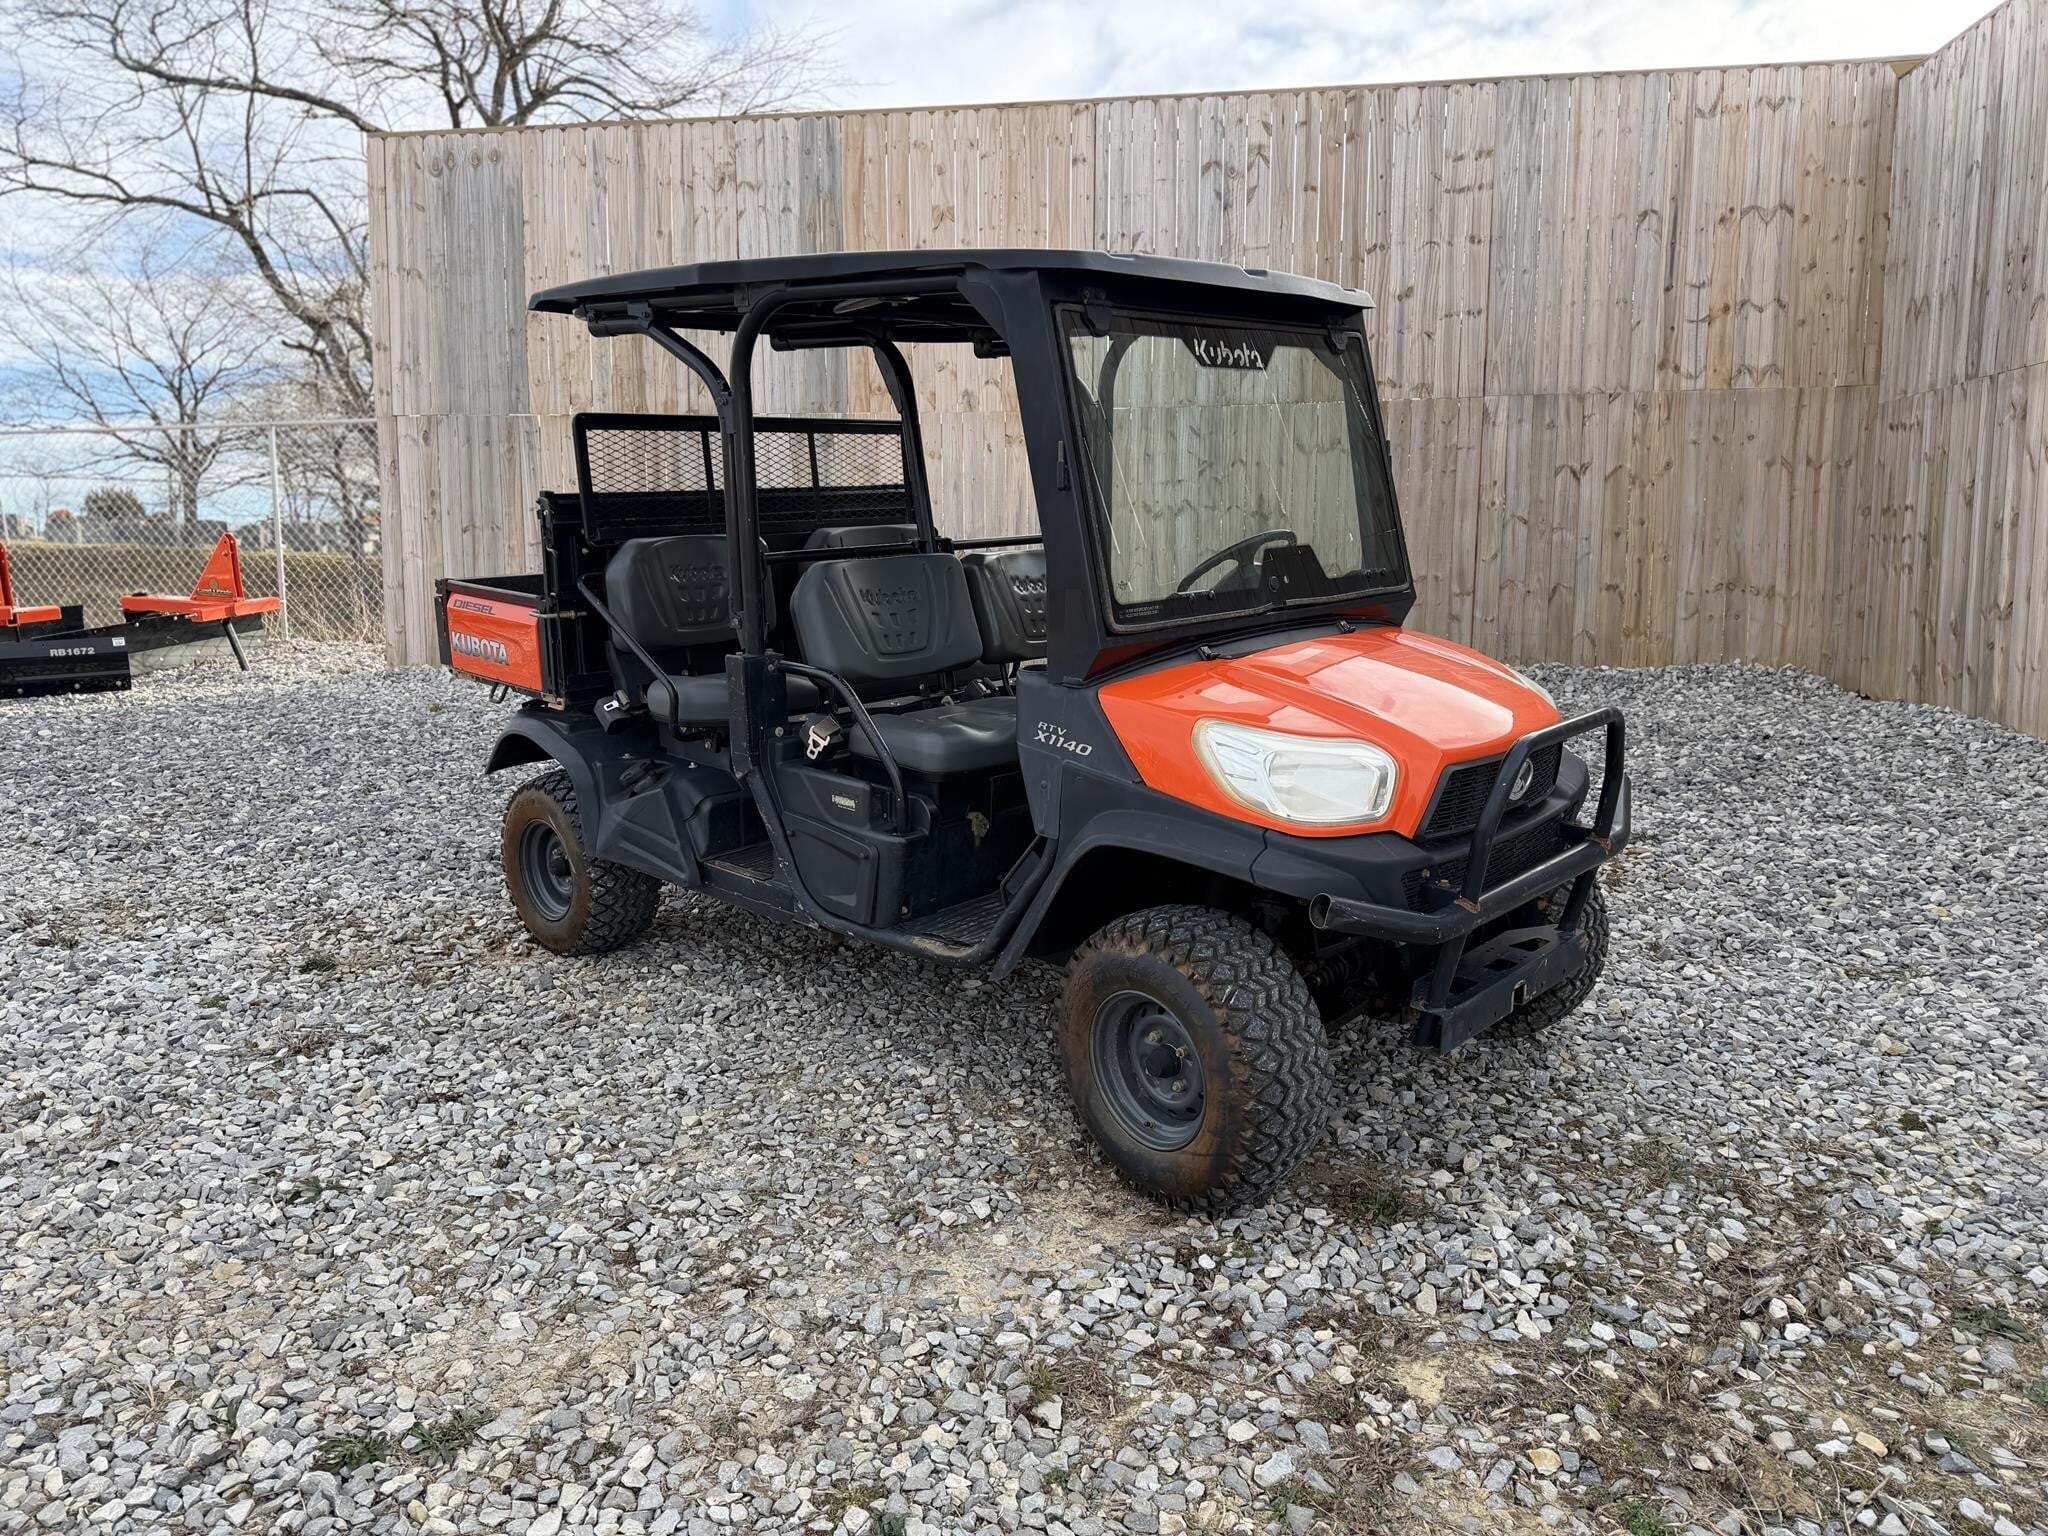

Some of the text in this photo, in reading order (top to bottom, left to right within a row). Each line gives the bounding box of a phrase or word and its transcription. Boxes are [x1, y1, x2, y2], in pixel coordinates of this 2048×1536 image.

[1194, 338, 1265, 368] Kubota
[859, 587, 919, 606] Kubota
[453, 599, 496, 616] DIESEL
[49, 647, 96, 657] RB1672
[451, 631, 510, 666] KUBOTA
[1038, 721, 1067, 735] RTV
[1033, 729, 1093, 756] X1140
